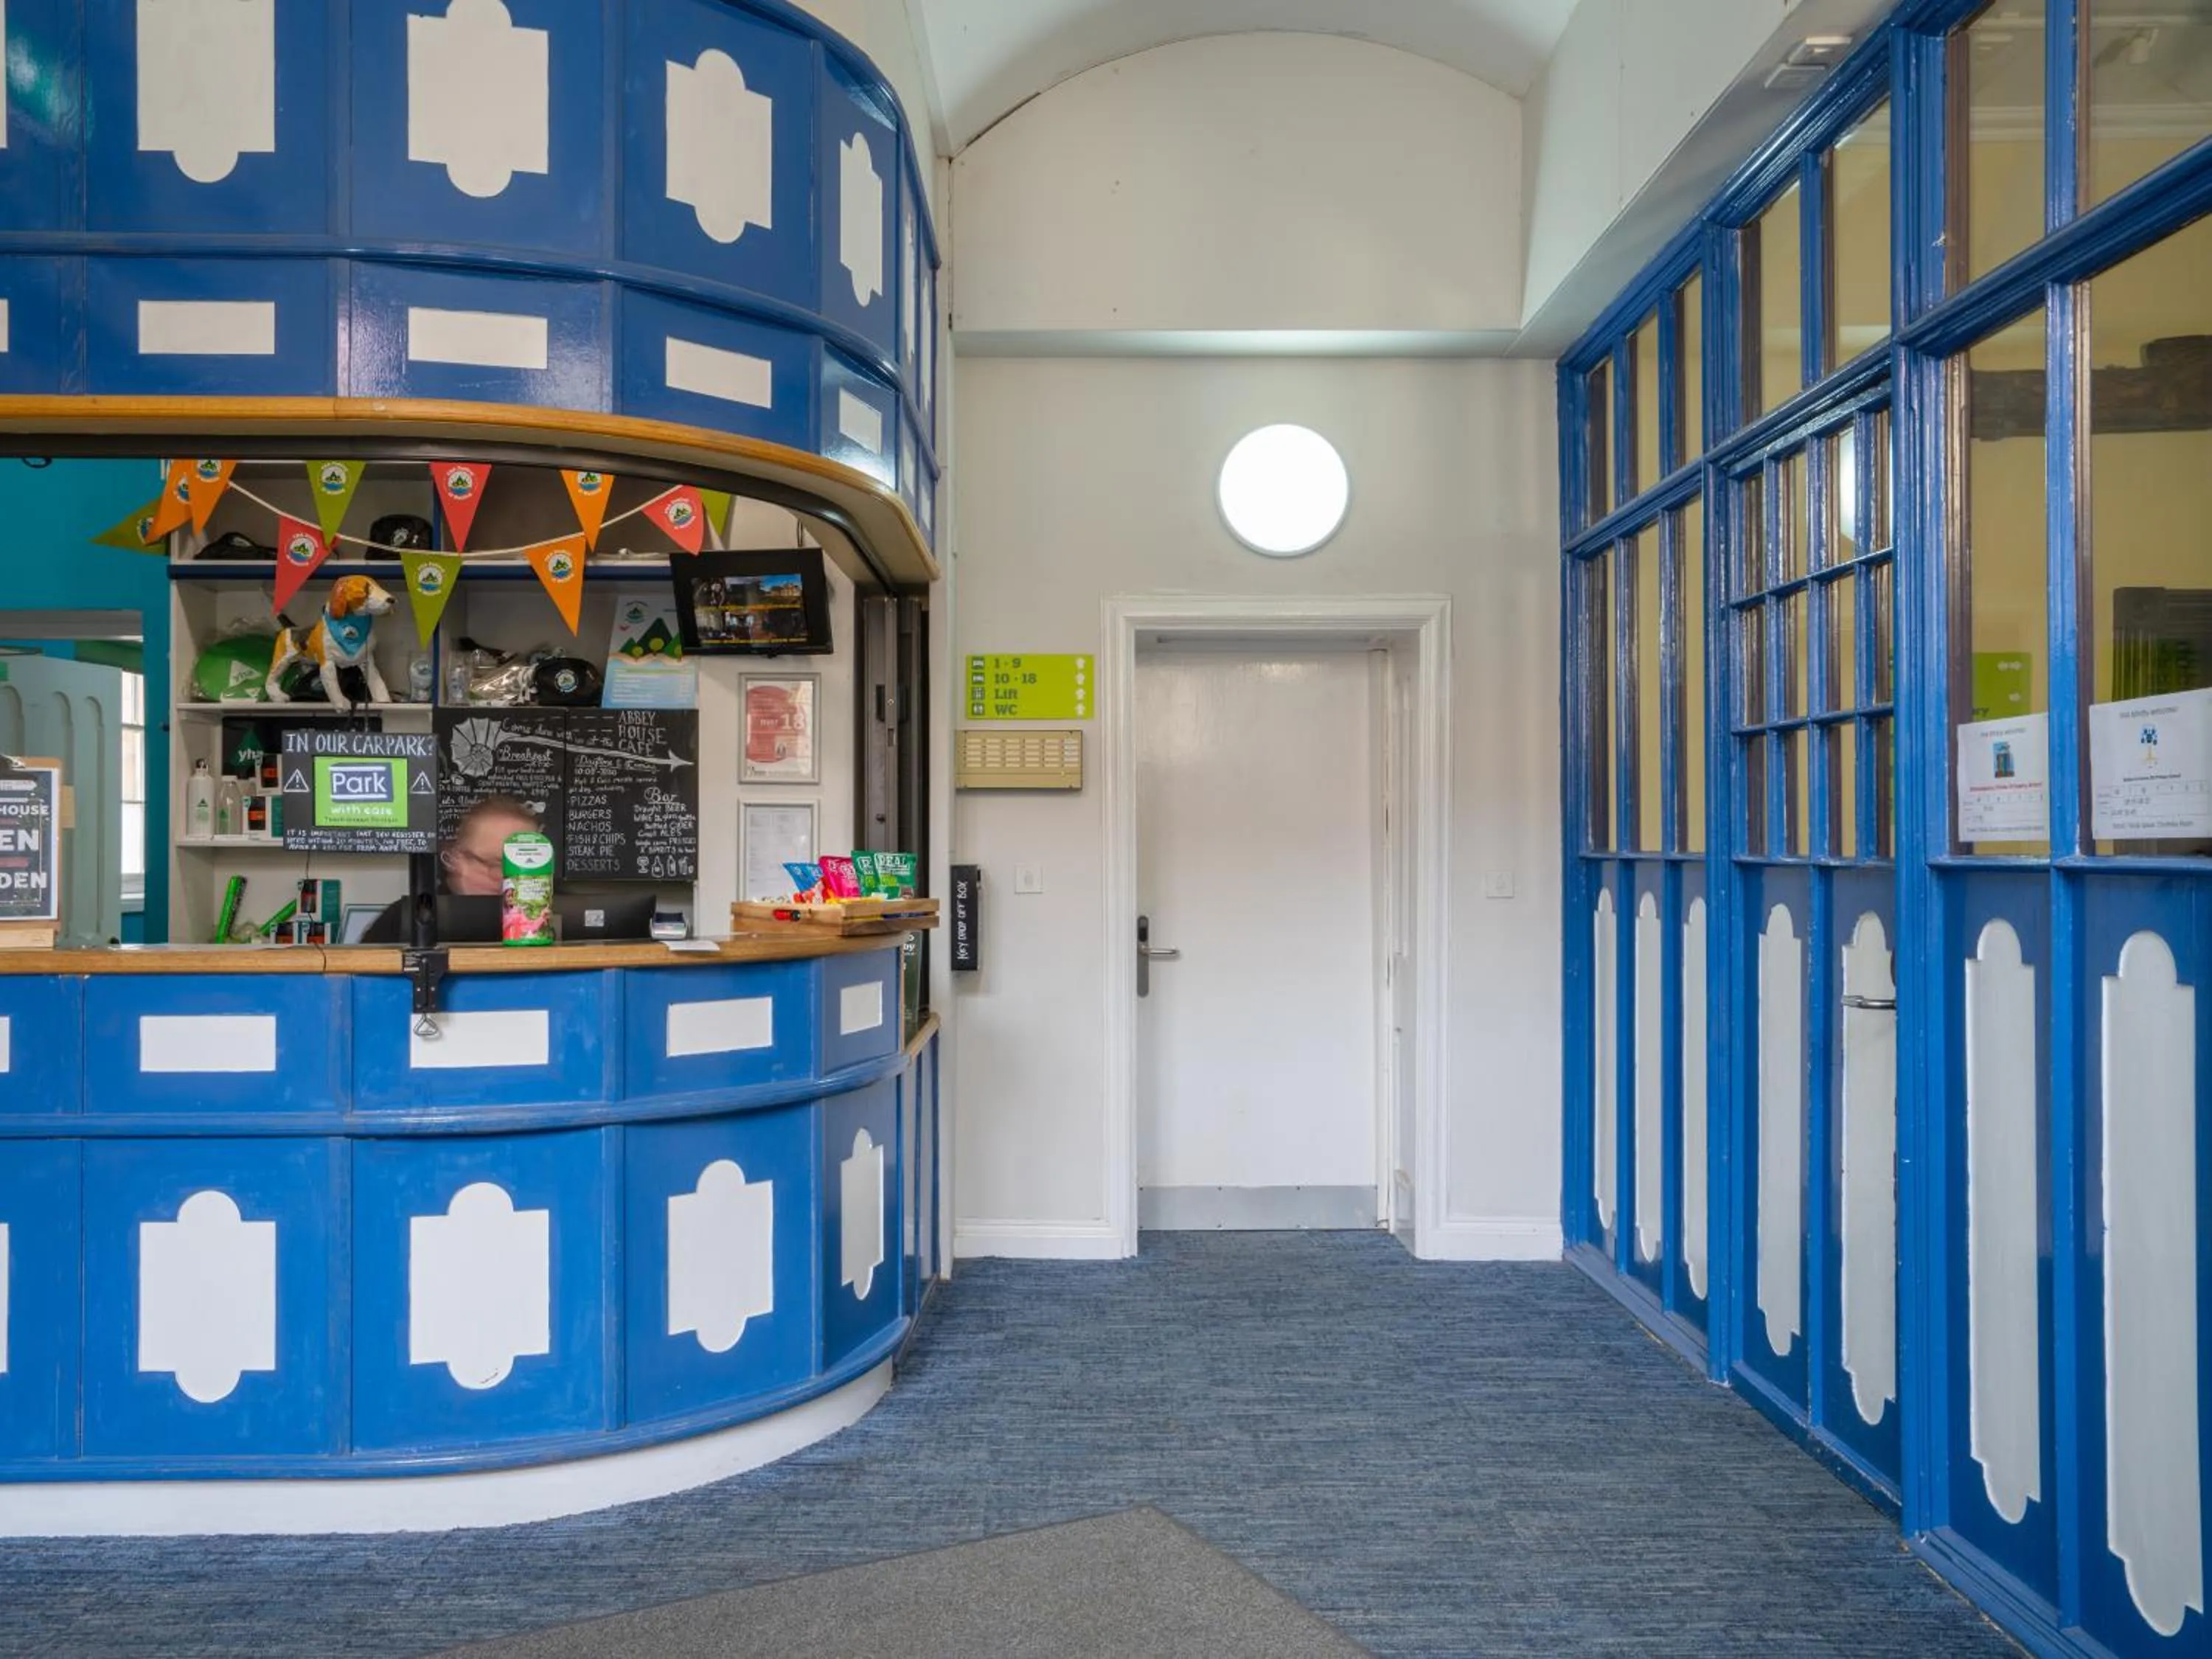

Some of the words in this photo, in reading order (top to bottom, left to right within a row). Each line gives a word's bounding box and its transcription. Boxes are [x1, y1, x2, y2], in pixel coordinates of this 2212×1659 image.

[995, 704, 1018, 715] WC
[618, 710, 656, 726] ABBEY
[618, 725, 668, 745] HOUSE
[285, 733, 308, 753] IN
[315, 734, 349, 754] OUR
[333, 772, 388, 794] Park
[570, 795, 608, 807] PIZZAS
[644, 786, 679, 803] Bar
[331, 805, 361, 815] with
[568, 809, 613, 821] BURGERS
[568, 821, 612, 833] NACHOS
[568, 845, 595, 857] STEAK
[599, 844, 616, 857] PIE
[567, 858, 621, 872] DESSERTS
[958, 881, 968, 900] BOX
[958, 902, 967, 919] OFF
[958, 921, 968, 940] DROP
[958, 942, 968, 959] KEY
